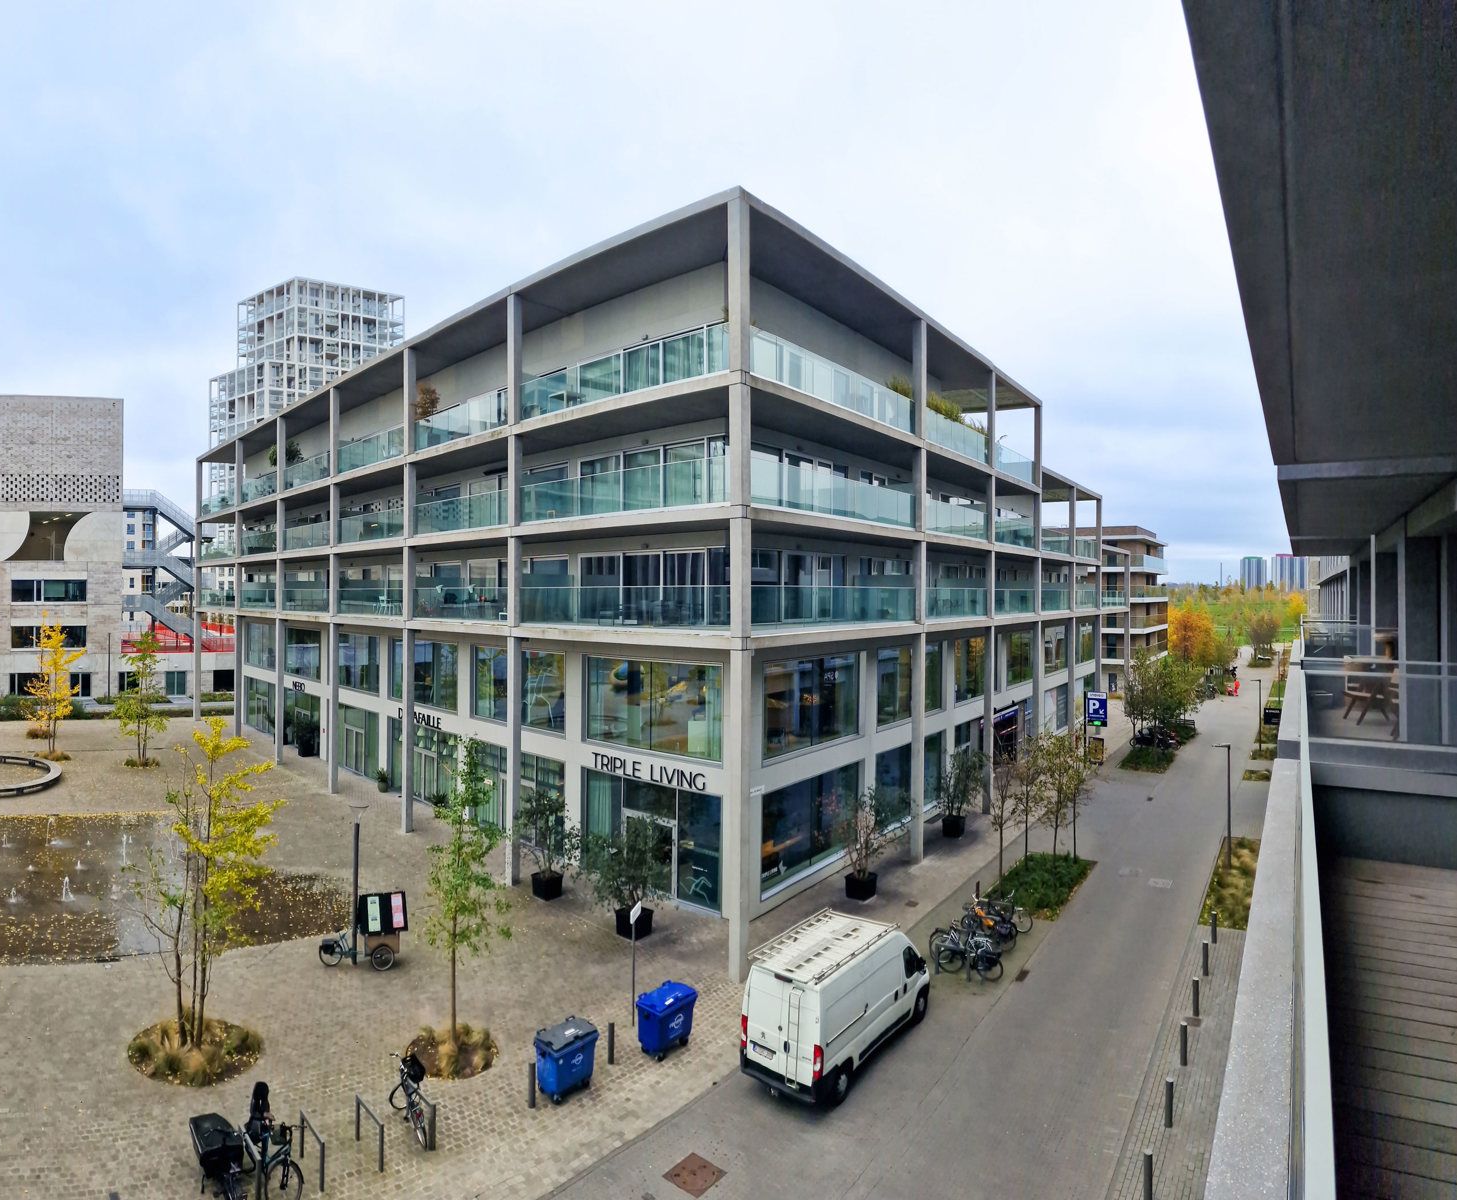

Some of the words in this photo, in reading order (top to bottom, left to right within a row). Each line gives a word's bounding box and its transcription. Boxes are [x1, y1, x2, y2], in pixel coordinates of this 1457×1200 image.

[1089, 699, 1100, 714] P
[591, 751, 642, 779] TRIPLE
[649, 763, 706, 791] LIVING
